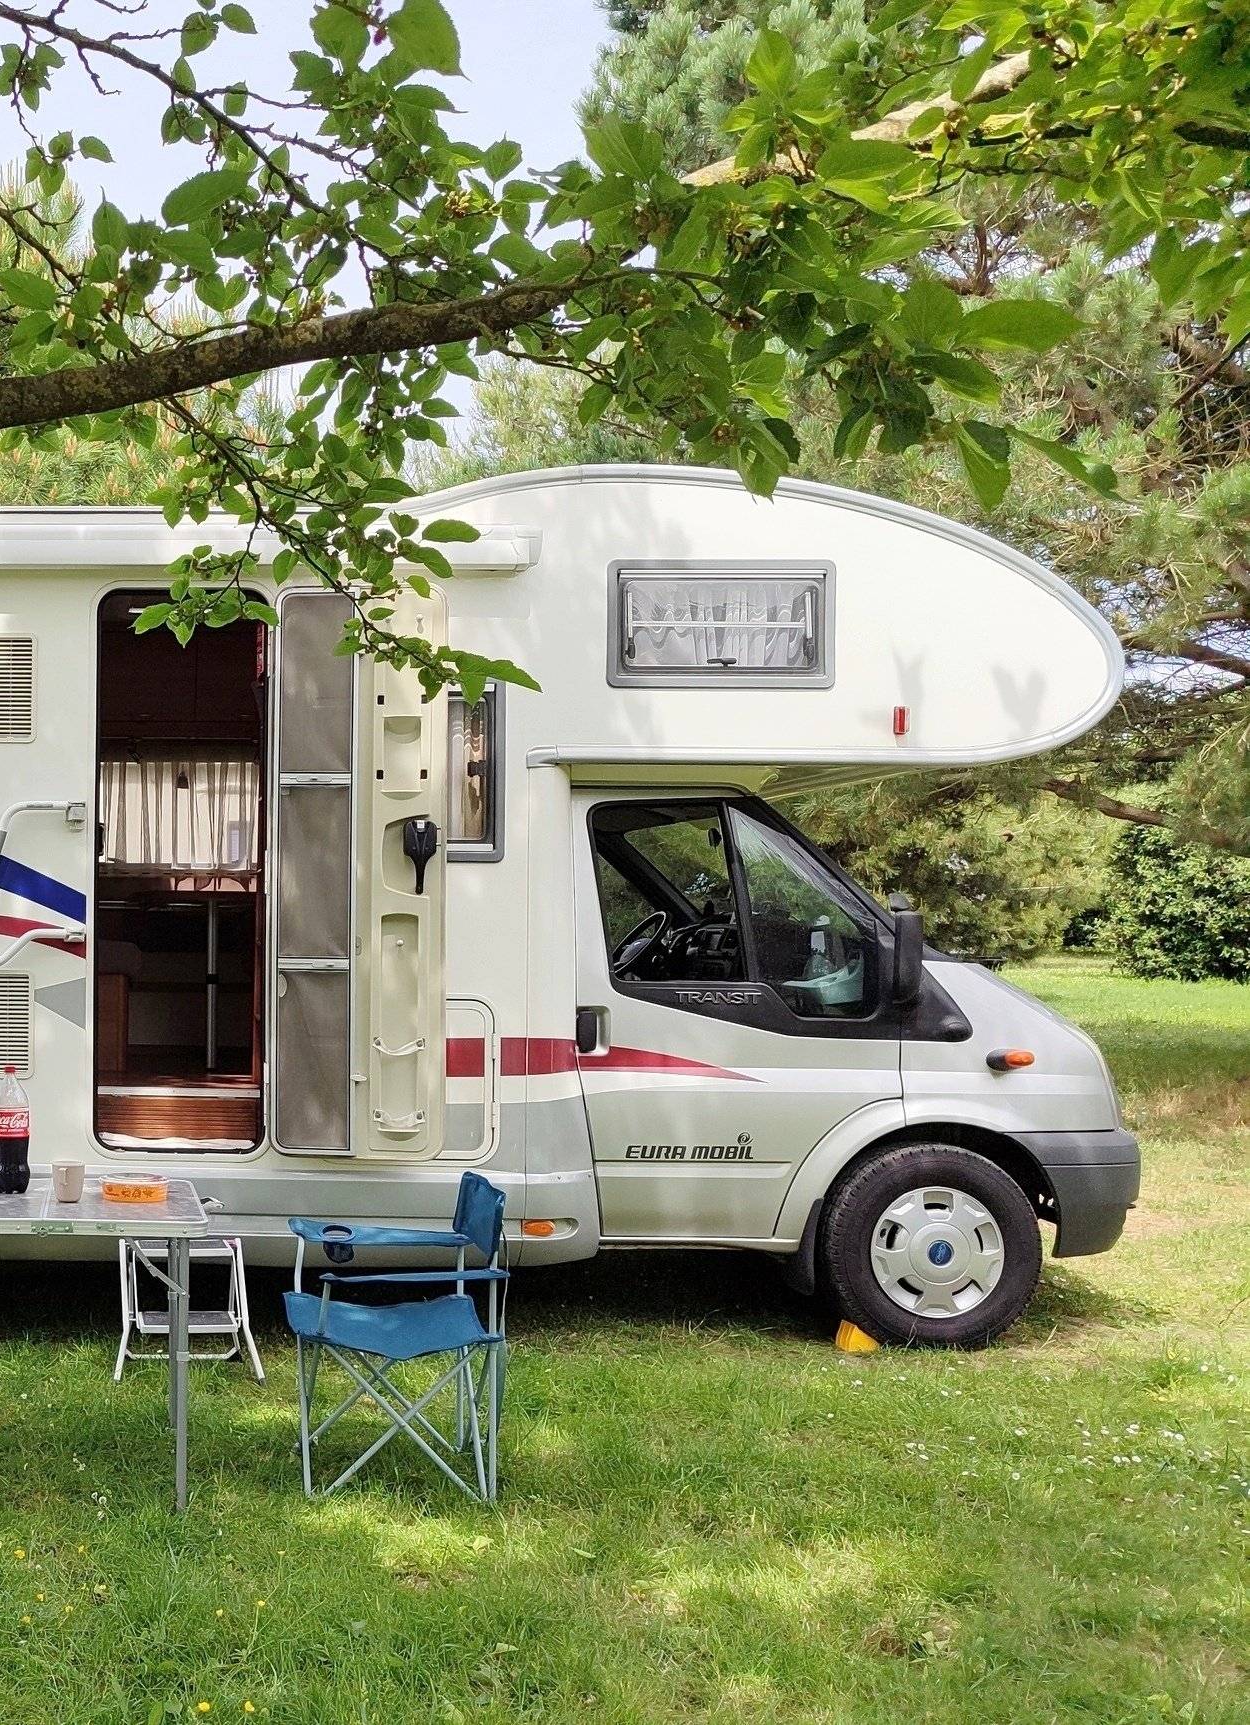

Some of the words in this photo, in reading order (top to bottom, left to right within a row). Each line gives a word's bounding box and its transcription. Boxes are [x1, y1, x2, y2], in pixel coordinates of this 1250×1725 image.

[675, 991, 762, 1004] TRANSIT
[625, 1145, 687, 1159] EURA
[690, 1145, 754, 1160] MOBIL
